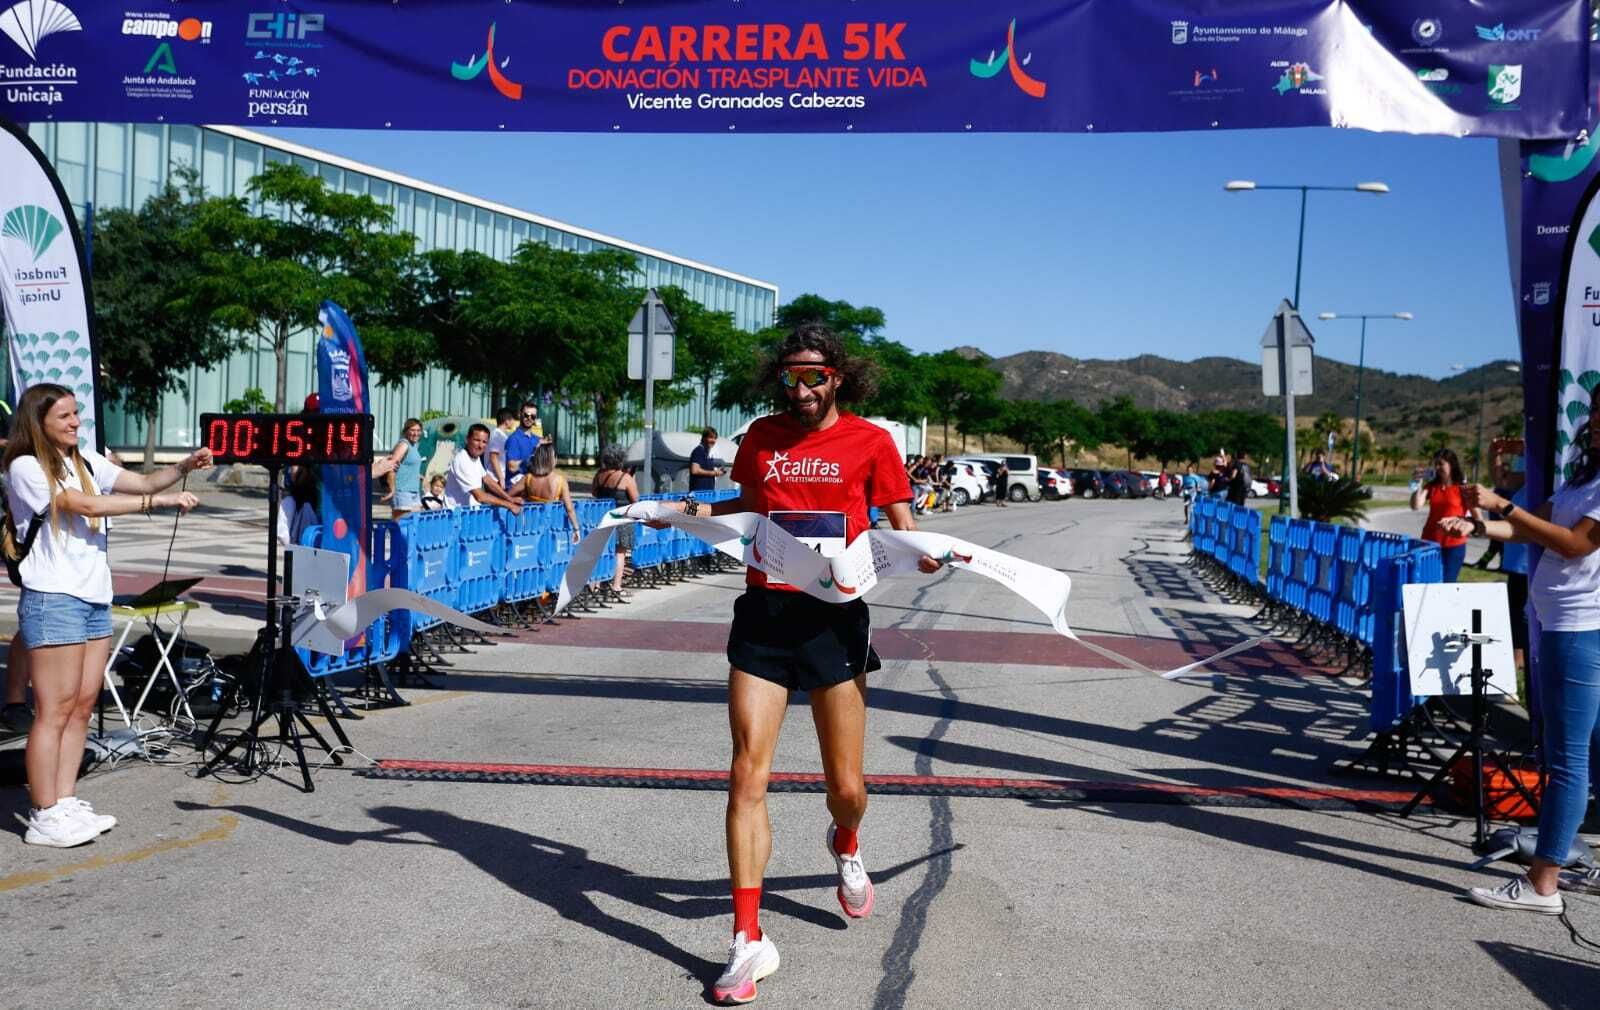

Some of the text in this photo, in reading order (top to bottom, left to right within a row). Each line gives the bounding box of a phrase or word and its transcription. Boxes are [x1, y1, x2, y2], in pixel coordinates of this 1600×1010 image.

[1192, 26, 1309, 37] Ayuntamiento de Málaga
[1505, 29, 1543, 41] ONT
[602, 22, 907, 62] CARRERA 5K
[122, 75, 197, 86] Junta de Andalucía
[567, 63, 928, 90] DONACIÓN TRASPLANTE VIDA
[7, 85, 63, 105] Unicaja
[249, 89, 310, 100] FUNDACIÓN
[626, 91, 866, 110] Vicente Granados Cabezas
[247, 99, 309, 118] persán
[209, 419, 359, 457] 00:15:14
[781, 457, 840, 476] califas
